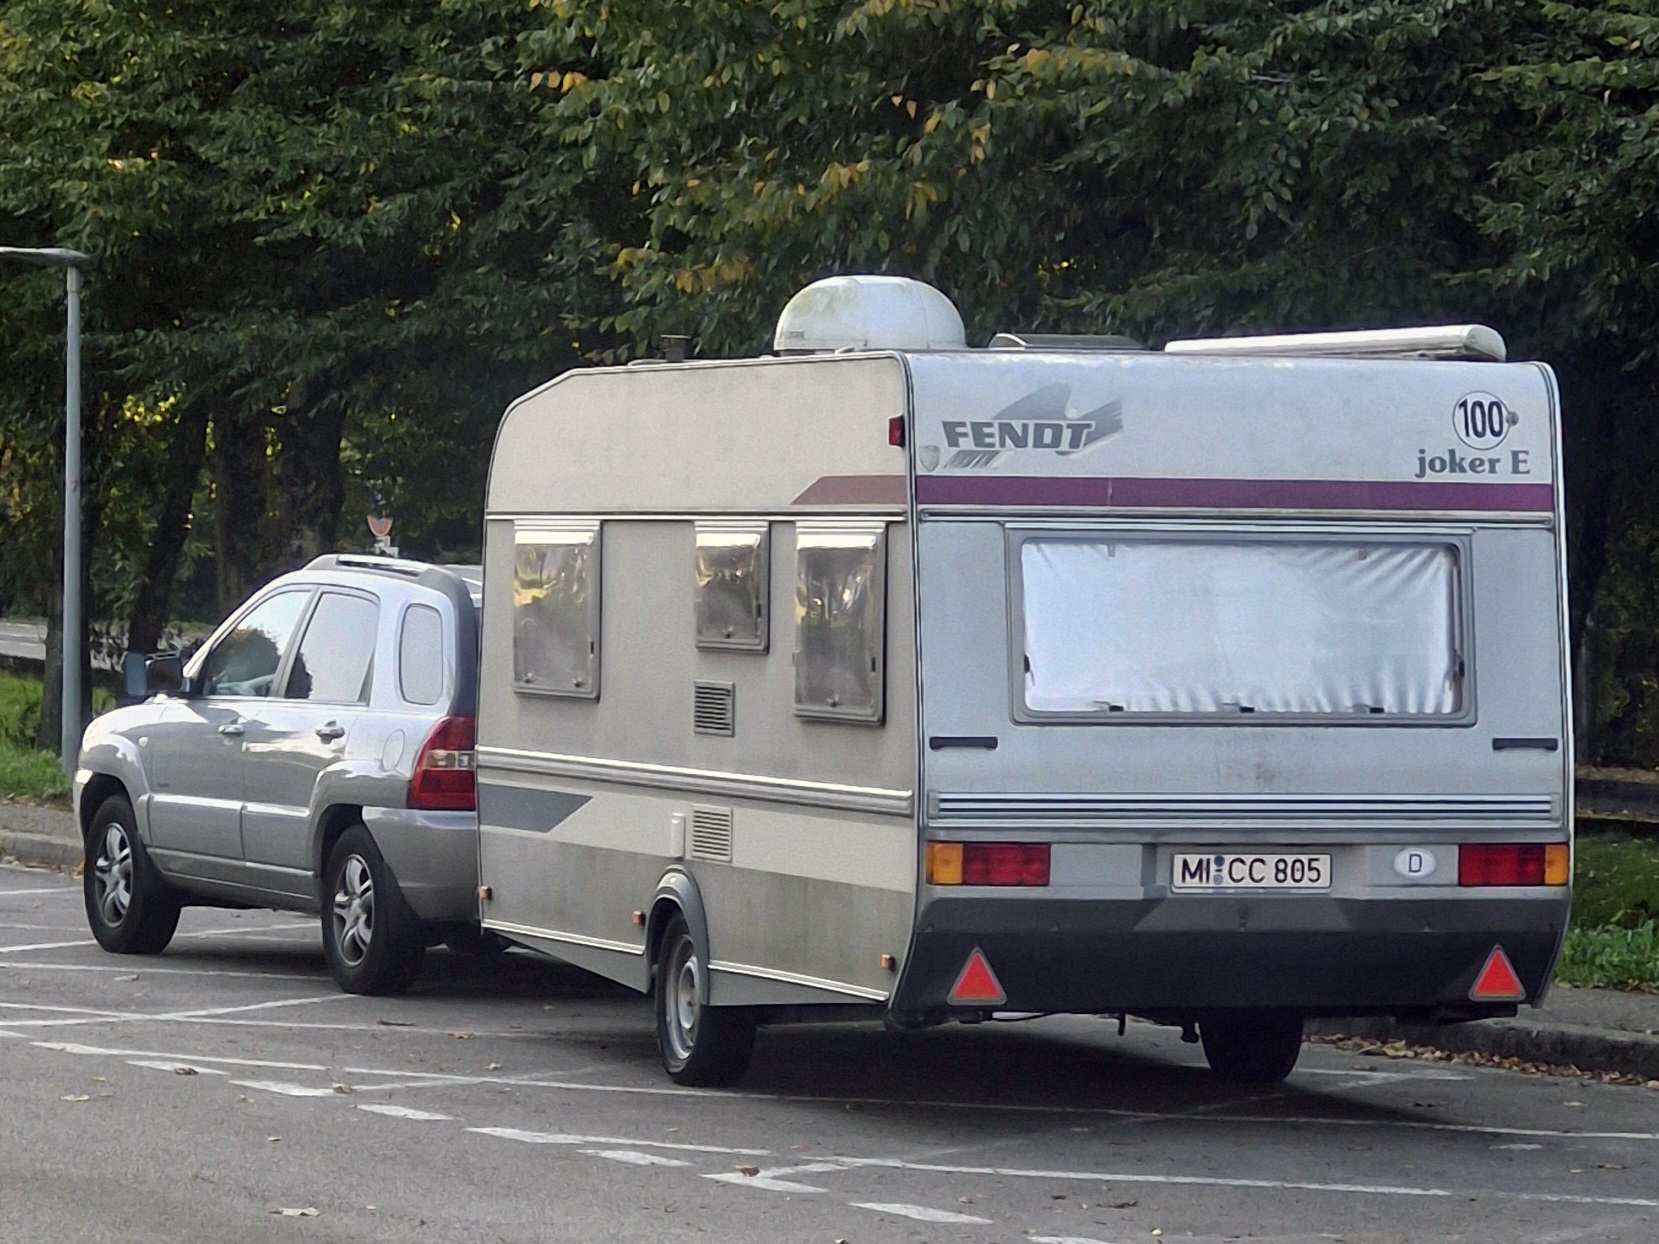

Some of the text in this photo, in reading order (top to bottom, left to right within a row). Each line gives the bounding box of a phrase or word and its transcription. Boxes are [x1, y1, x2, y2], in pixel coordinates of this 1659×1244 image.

[1458, 398, 1504, 439] 100
[941, 420, 1093, 450] FENDT
[1414, 448, 1531, 479] joker E
[1274, 857, 1321, 884] 805
[1408, 853, 1423, 873] D
